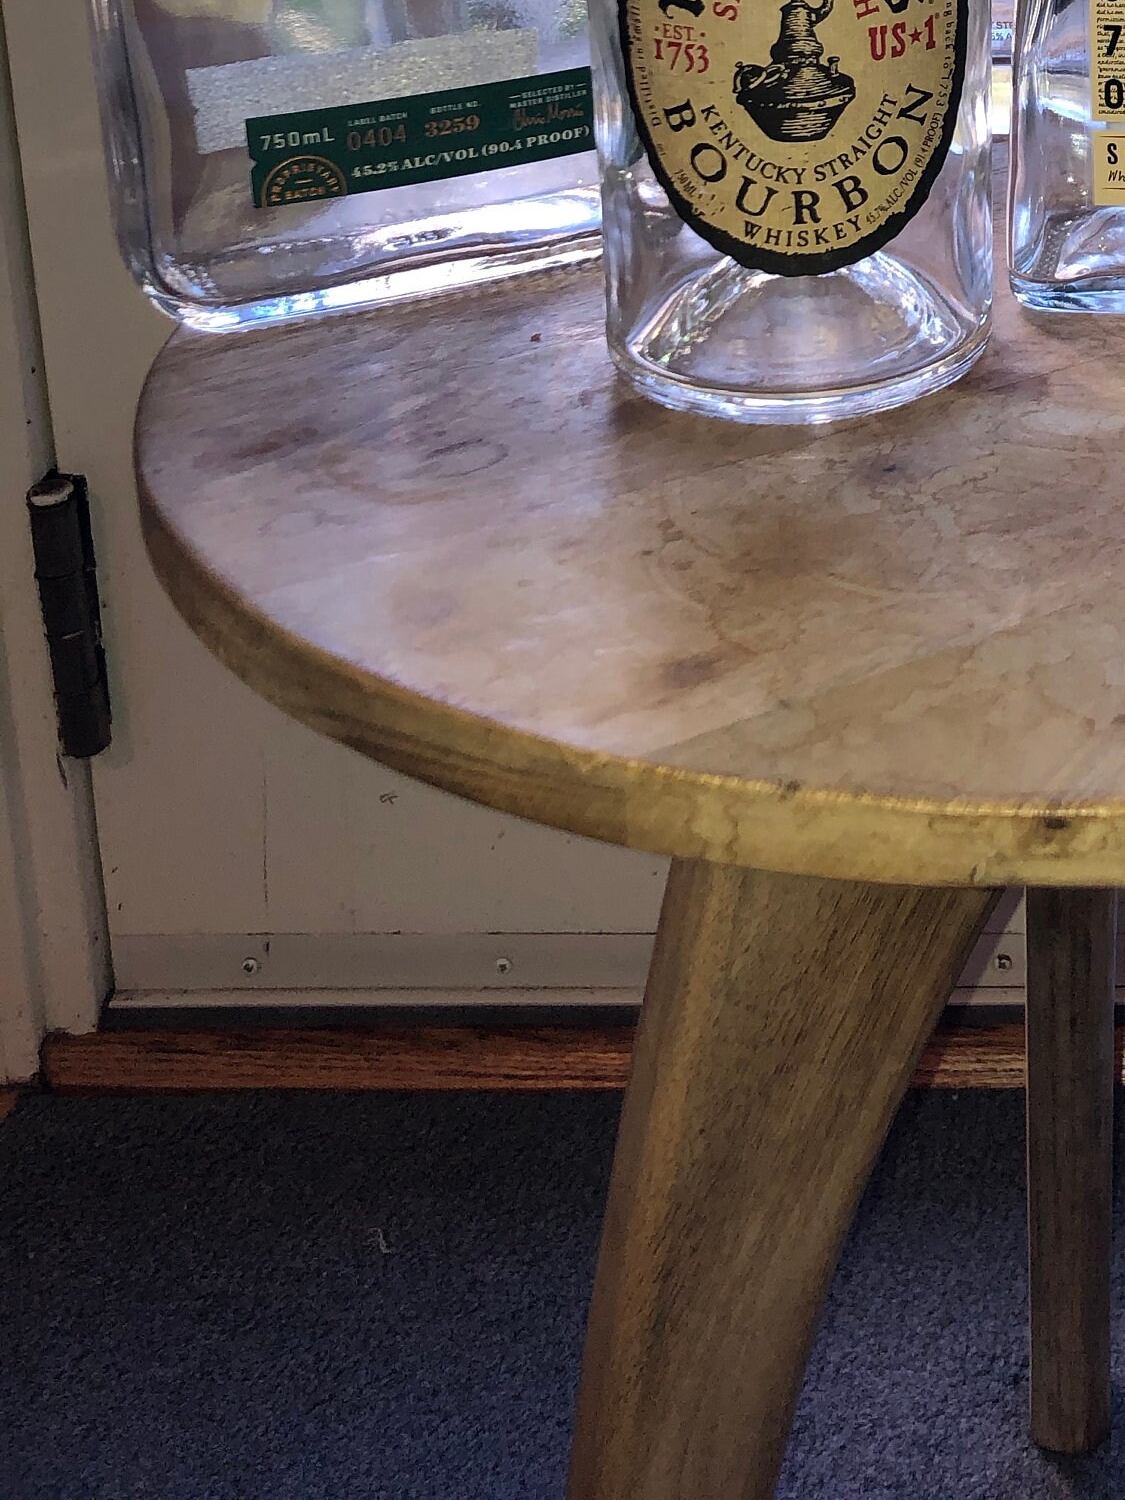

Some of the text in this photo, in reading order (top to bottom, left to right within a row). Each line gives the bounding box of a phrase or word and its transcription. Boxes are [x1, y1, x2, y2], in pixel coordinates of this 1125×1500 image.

[662, 23, 698, 42] EST.
[654, 38, 710, 74] 1753
[259, 126, 336, 151] 750mL
[346, 123, 407, 151] 0404
[424, 114, 480, 138] 3259
[701, 93, 898, 185] KENTUCKY STRAIGHT
[923, 112, 943, 149] PROOF)
[351, 160, 400, 178] 45.2%
[400, 147, 479, 171] ALC/VOL
[526, 124, 590, 148] PROOF)
[663, 83, 934, 225] BOURBON
[744, 214, 862, 247] WHISKEY
